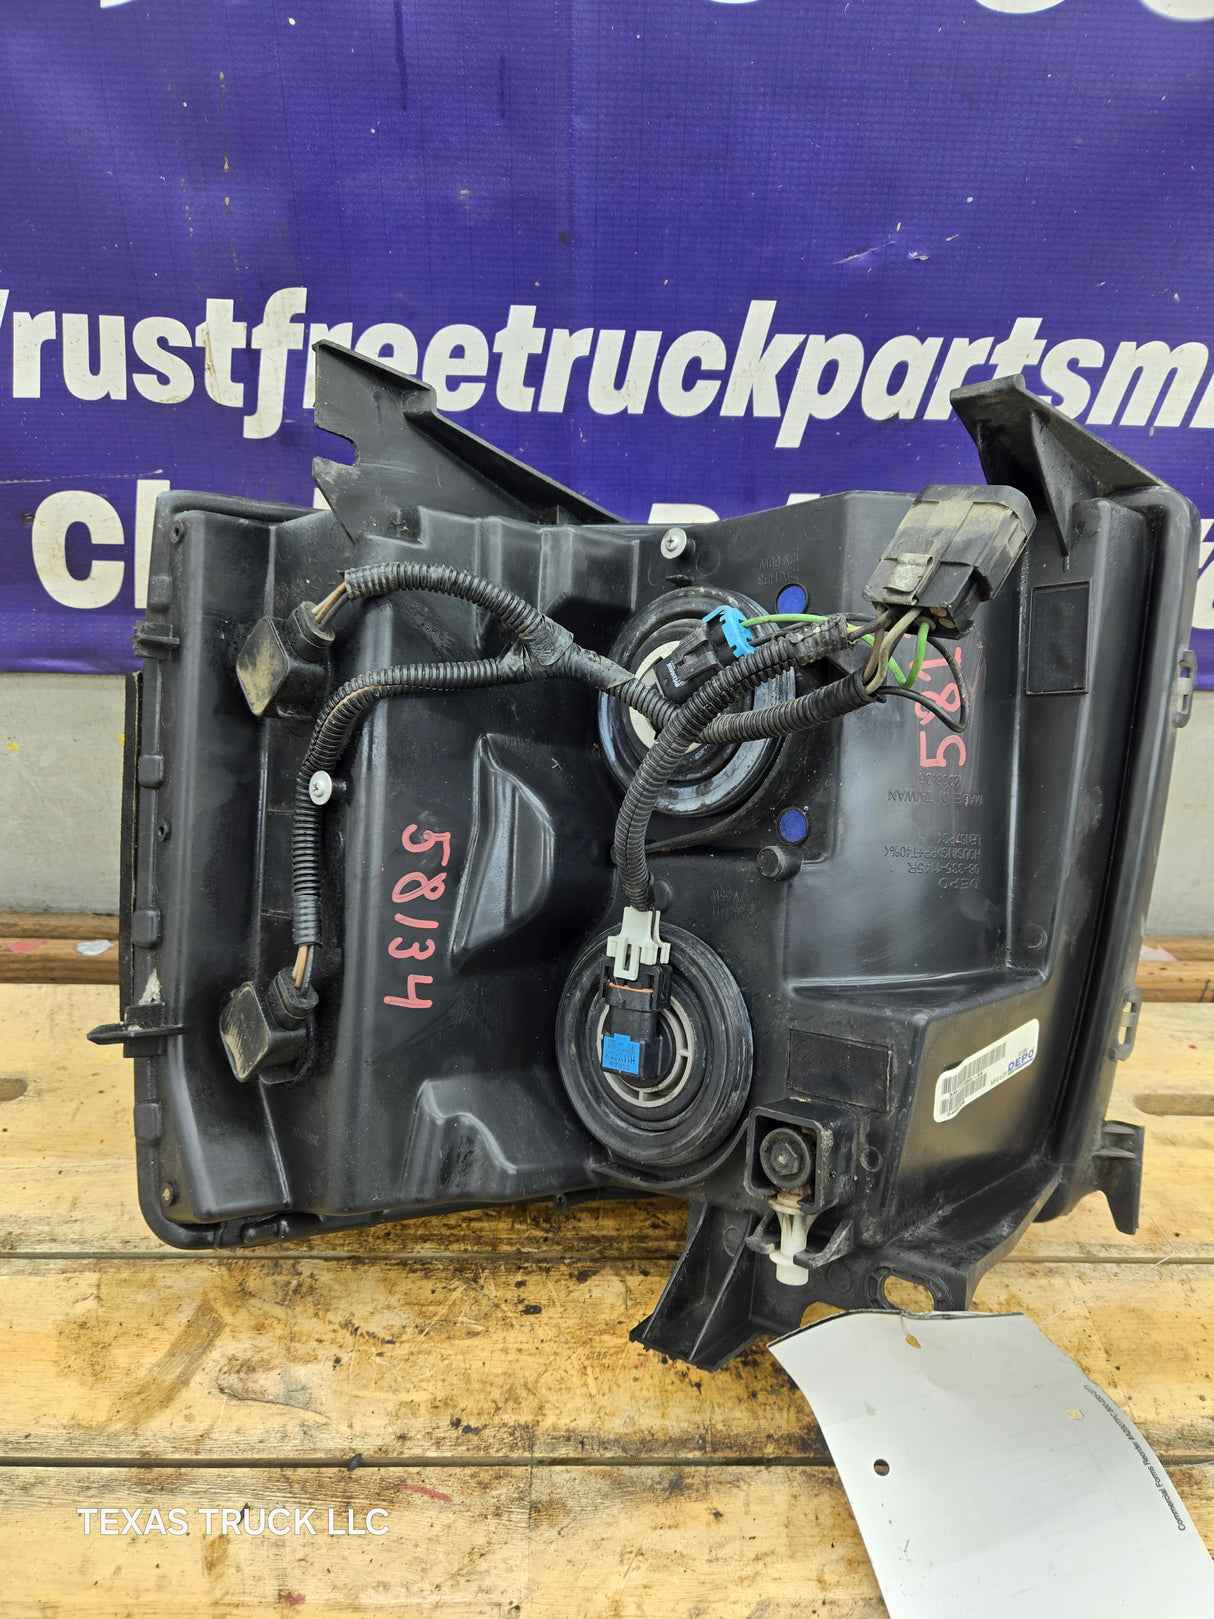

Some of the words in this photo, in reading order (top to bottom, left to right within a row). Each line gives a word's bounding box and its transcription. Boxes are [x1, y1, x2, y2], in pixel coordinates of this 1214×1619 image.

[887, 788, 934, 804] TAIWAN
[954, 792, 983, 807] MADE
[937, 877, 980, 890] DEPO
[384, 824, 451, 1008] 58134
[1007, 1049, 1035, 1072] DEPO
[1132, 1441, 1150, 1466] Reorder
[1147, 1466, 1163, 1488] Forms
[1158, 1487, 1187, 1531] Commercial
